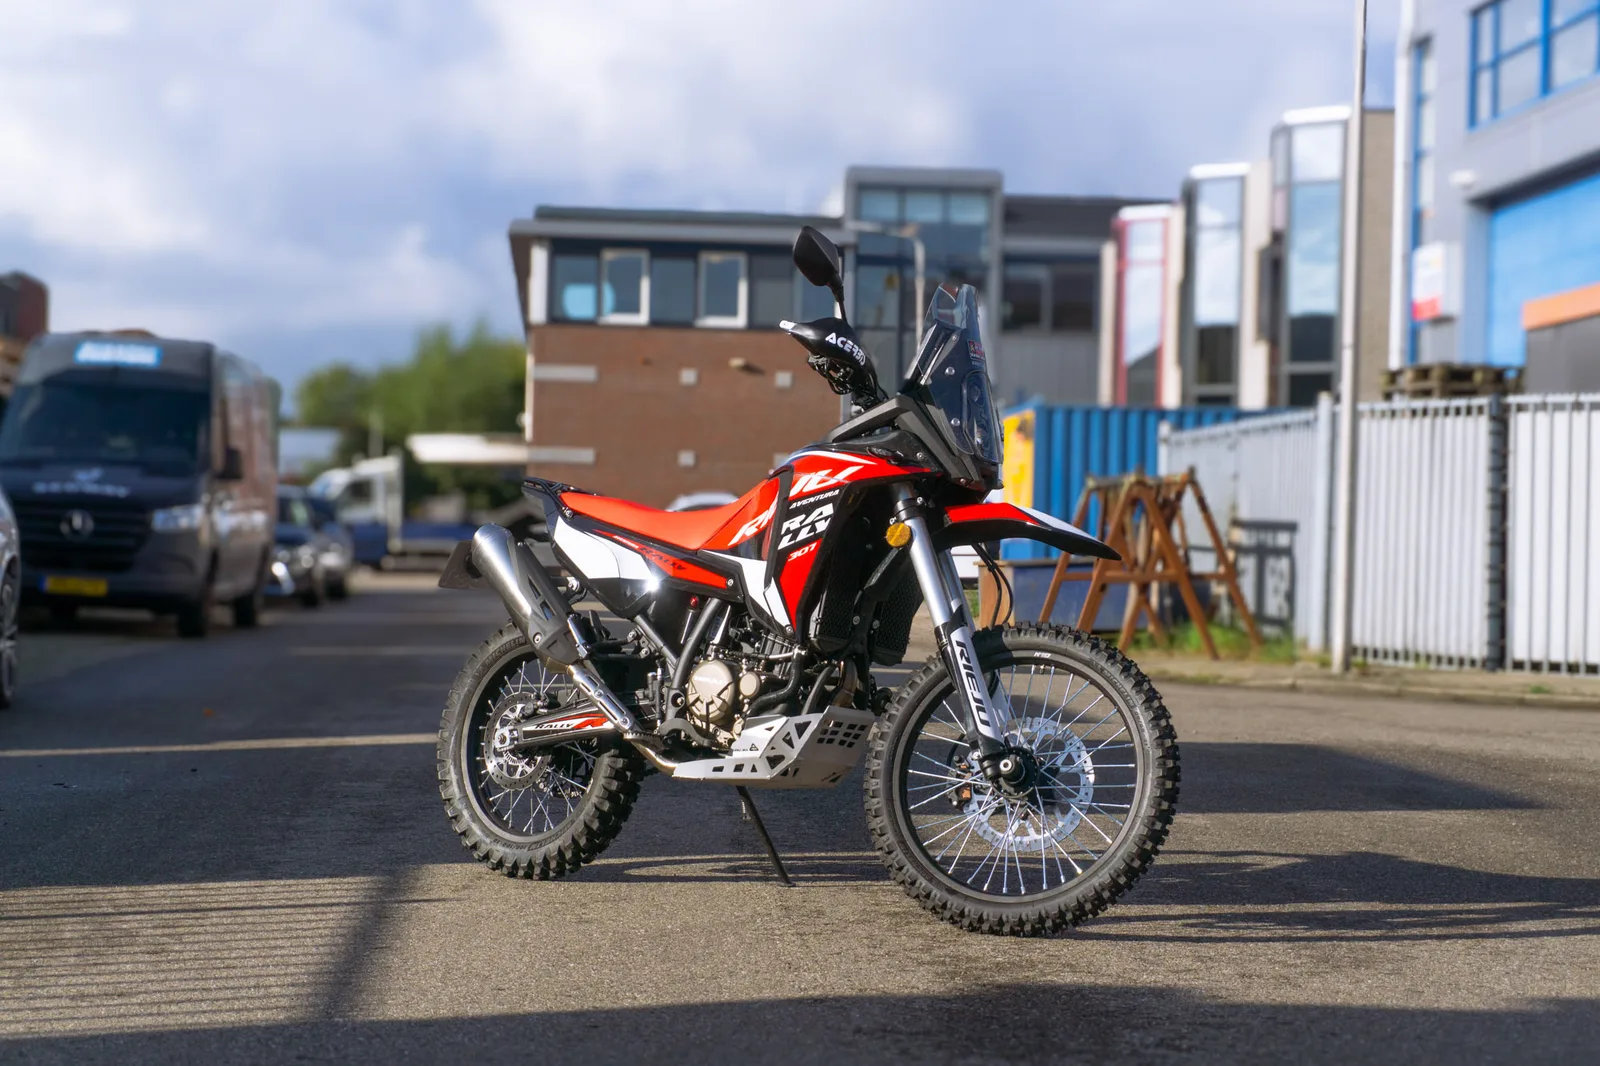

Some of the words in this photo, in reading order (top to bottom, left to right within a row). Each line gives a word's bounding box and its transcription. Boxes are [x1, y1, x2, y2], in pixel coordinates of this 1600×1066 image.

[789, 489, 840, 510] AVENTURA
[787, 541, 818, 562] 307
[485, 636, 527, 666] MICHELIN
[956, 640, 991, 728] RIEJU
[535, 722, 574, 730] RALLY
